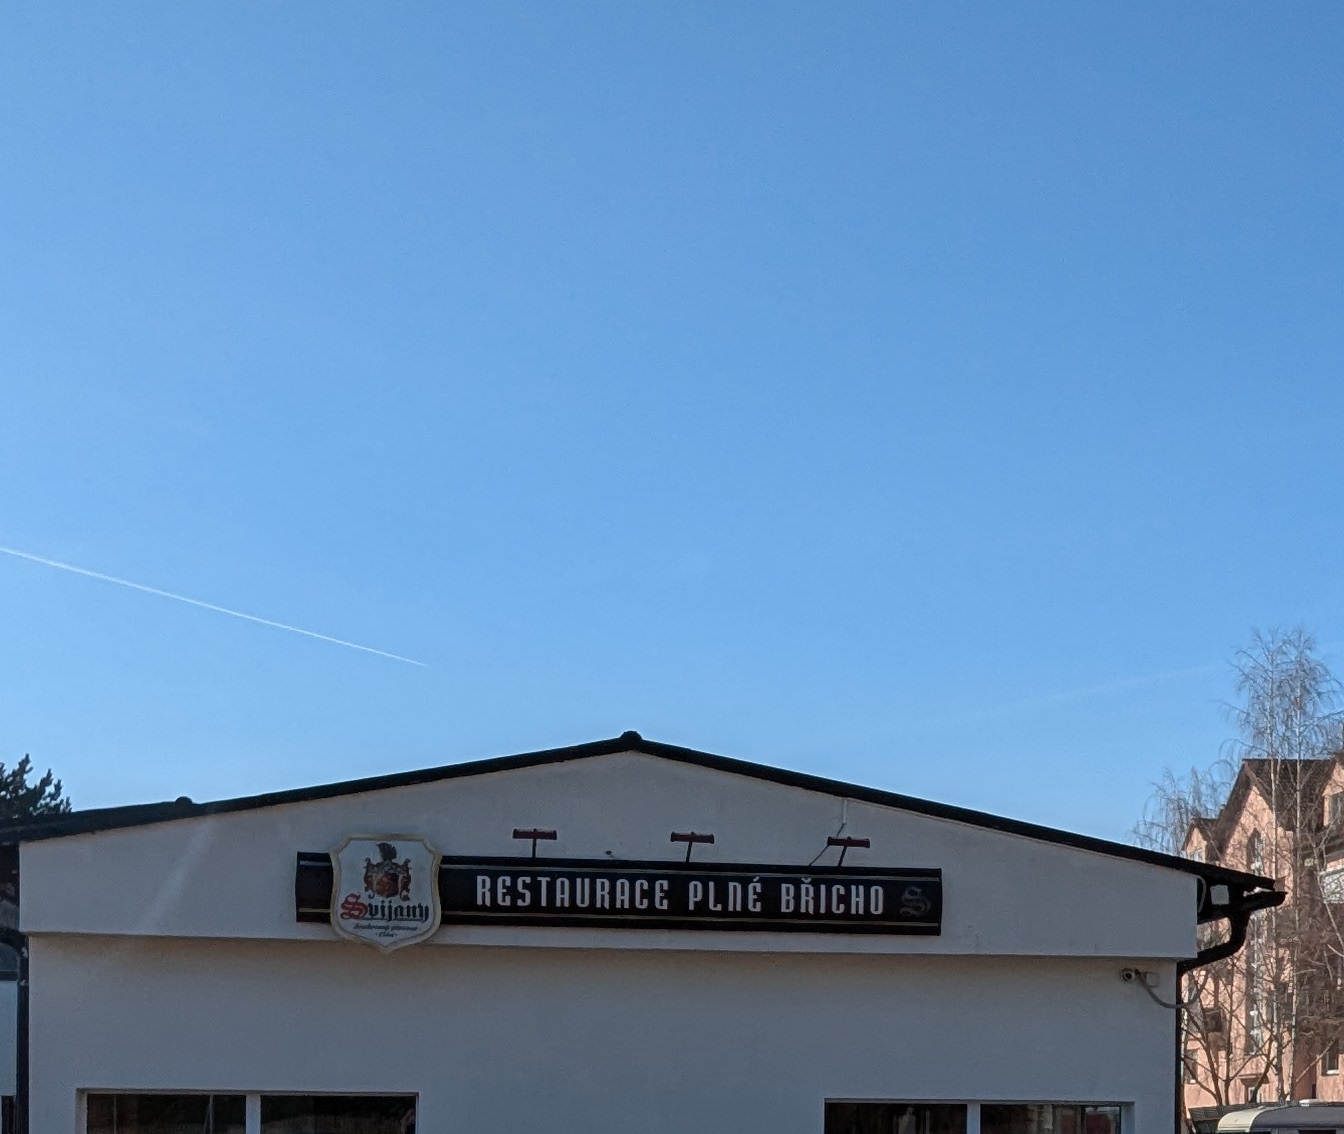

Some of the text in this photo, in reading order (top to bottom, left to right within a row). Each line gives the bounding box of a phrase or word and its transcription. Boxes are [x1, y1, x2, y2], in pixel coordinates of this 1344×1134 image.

[340, 893, 430, 924] Svijany
[476, 875, 884, 915] RESTAURACE PLNÉ BŘICHO
